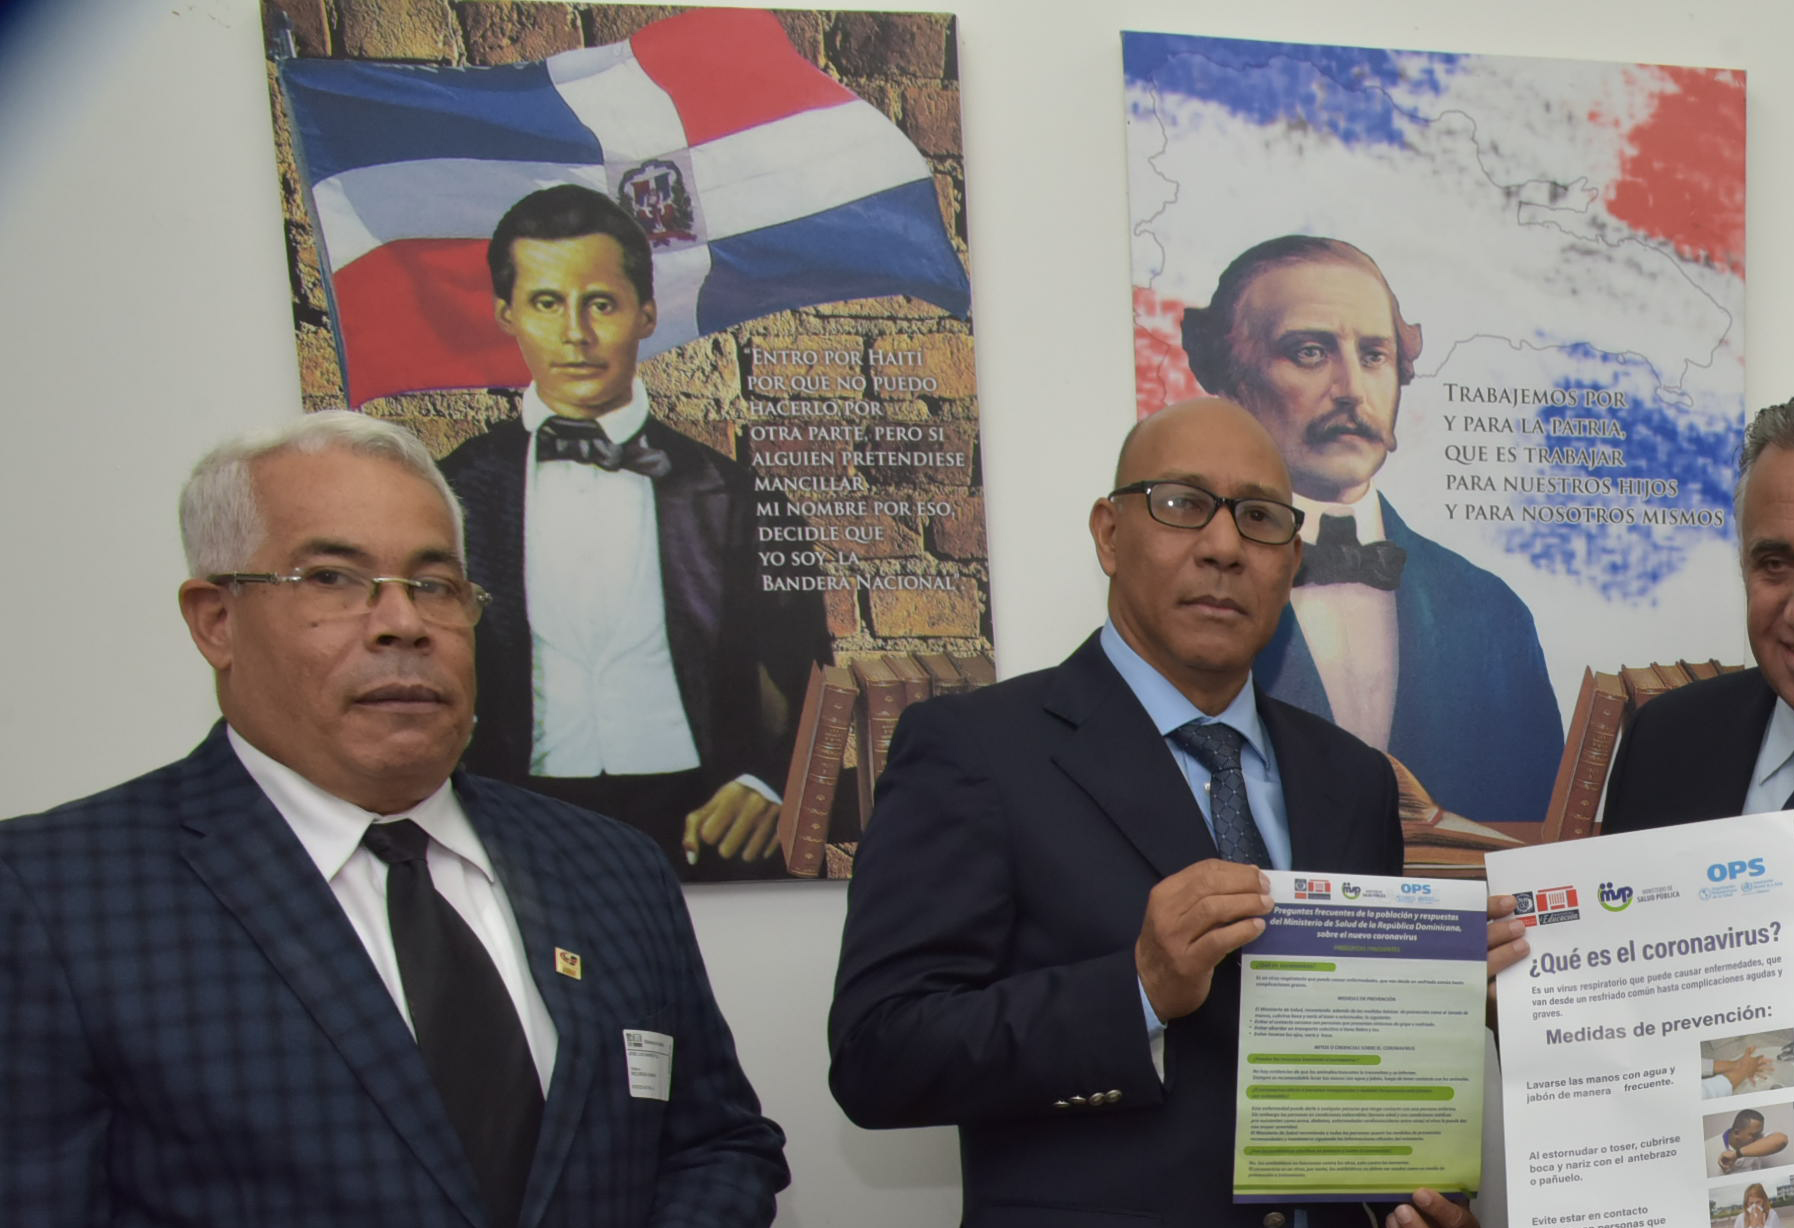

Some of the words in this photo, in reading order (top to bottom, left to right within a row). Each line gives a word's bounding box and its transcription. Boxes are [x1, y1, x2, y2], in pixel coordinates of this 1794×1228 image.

[824, 350, 864, 366] POR
[747, 376, 786, 392] POR
[791, 376, 830, 394] QUE
[838, 376, 866, 392] NO
[872, 376, 937, 392] PUEDO
[1443, 383, 1577, 408] TRABAJEMOS
[1586, 391, 1627, 408] POR
[844, 402, 884, 416] POR
[751, 426, 801, 442] OTRA
[875, 427, 923, 442] PERO
[928, 427, 944, 442] SI
[1443, 415, 1457, 432] Y
[1464, 416, 1514, 434] PARA
[1521, 418, 1545, 435] LA
[1552, 419, 1627, 439] PATRIA,
[752, 452, 834, 467] ALGUIEN
[842, 452, 966, 467] PRETENDIESE
[1445, 445, 1488, 465] QUE
[1496, 446, 1517, 464] ES
[1524, 447, 1626, 469] TRABAJAR
[754, 476, 866, 492] MANCILLAR
[1446, 474, 1496, 492] PARA
[1503, 476, 1611, 495] NUESTROS
[1619, 478, 1679, 500] HIJOS
[756, 502, 779, 517] MI
[786, 502, 867, 517] NOMBRE
[874, 502, 912, 517] POR
[1445, 504, 1458, 521] Y
[1465, 504, 1514, 522] PARA
[1521, 505, 1635, 524] NOSOTROS
[1642, 508, 1725, 527] MISMOS
[758, 526, 838, 542] DECIDLE
[845, 526, 884, 544] QUE
[758, 552, 785, 567] YO
[791, 552, 826, 567] SOY
[838, 552, 860, 566] LA
[762, 574, 851, 592] BANDERA
[1707, 857, 1766, 882] OPS
[1401, 884, 1431, 894] OPS
[1529, 946, 1582, 978] ¿Qué
[1587, 947, 1612, 967] es
[1617, 940, 1636, 963] el
[1642, 921, 1781, 960] coronavirus?
[1532, 986, 1541, 994] Es
[1544, 986, 1554, 994] un
[1557, 984, 1578, 992] virus
[1580, 977, 1627, 991] respiratorio
[1629, 975, 1644, 986] que
[1647, 971, 1672, 983] puede
[1674, 967, 1701, 978] causar
[1705, 959, 1764, 974] enfermedades,
[1766, 956, 1782, 966] que
[1549, 996, 1574, 1005] desde
[1589, 990, 1625, 1002] resfriado
[1628, 986, 1655, 998] común
[1657, 984, 1679, 994] hasta
[1681, 974, 1744, 990] complicaciones
[1746, 969, 1776, 982] agudas
[1533, 1010, 1563, 1020] graves.
[1546, 1025, 1626, 1045] Medidas
[1633, 1022, 1656, 1037] de
[1662, 1004, 1772, 1036] prevención:
[1526, 1080, 1566, 1090] Lavarse
[1569, 1077, 1583, 1086] las
[1586, 1074, 1620, 1084] manos
[1623, 1071, 1641, 1080] con
[1643, 1067, 1667, 1079] agua
[1670, 1066, 1675, 1075] y
[1526, 1091, 1555, 1104] jabón
[1558, 1091, 1570, 1099] de
[1573, 1088, 1611, 1098] manera
[1624, 1079, 1674, 1092] frecuente.
